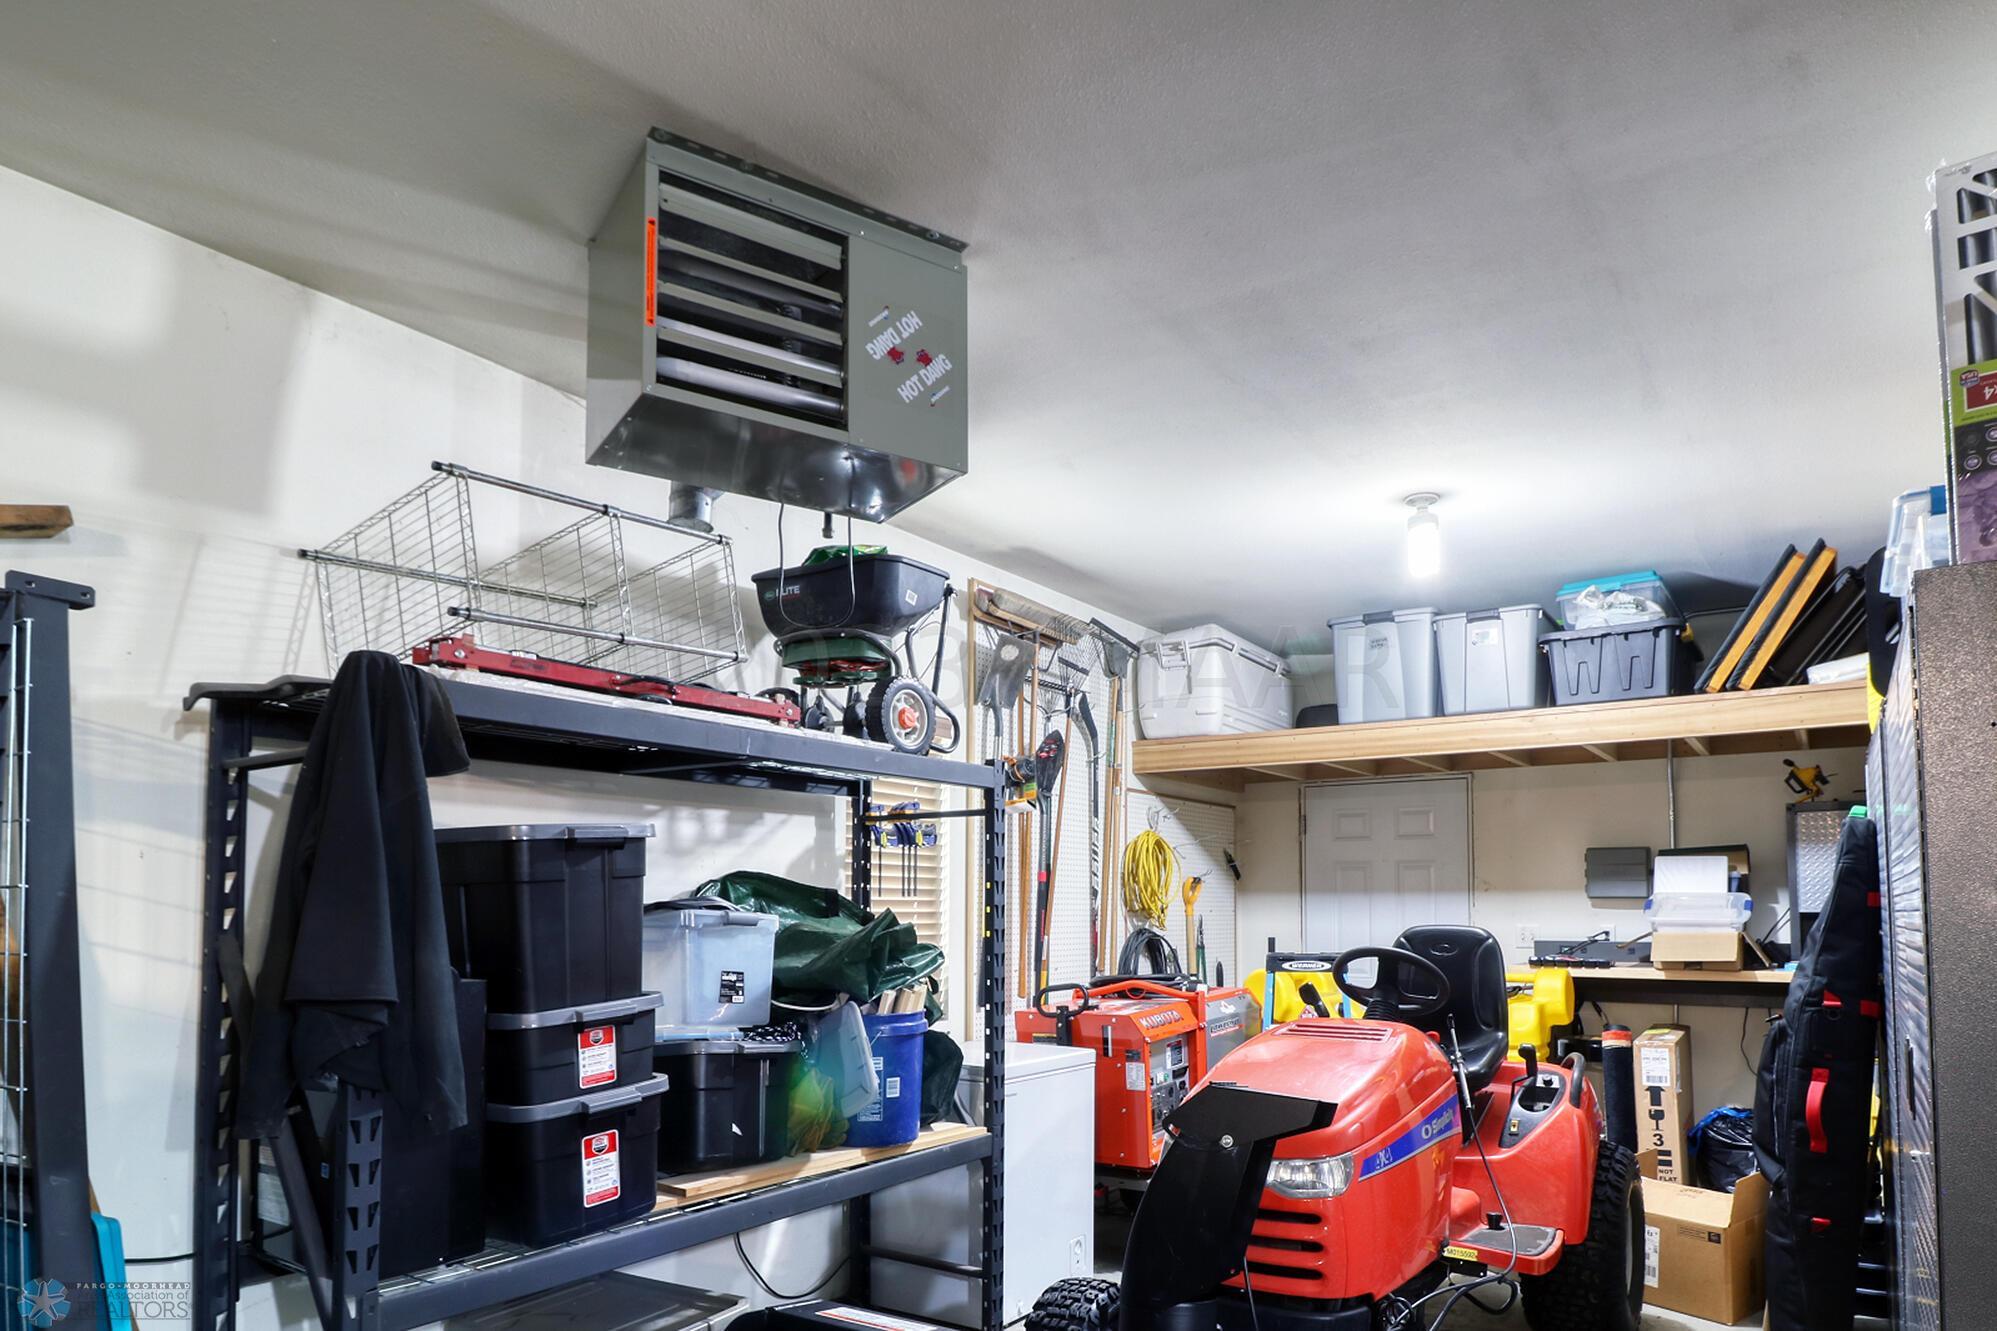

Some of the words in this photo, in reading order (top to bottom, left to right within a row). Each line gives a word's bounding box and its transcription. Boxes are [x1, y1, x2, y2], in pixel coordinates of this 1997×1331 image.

[895, 310, 923, 339] HOT
[865, 327, 902, 360] DAWG
[897, 374, 924, 403] HOT
[919, 354, 953, 386] DAWG
[1139, 1010, 1181, 1029] KUBOTA
